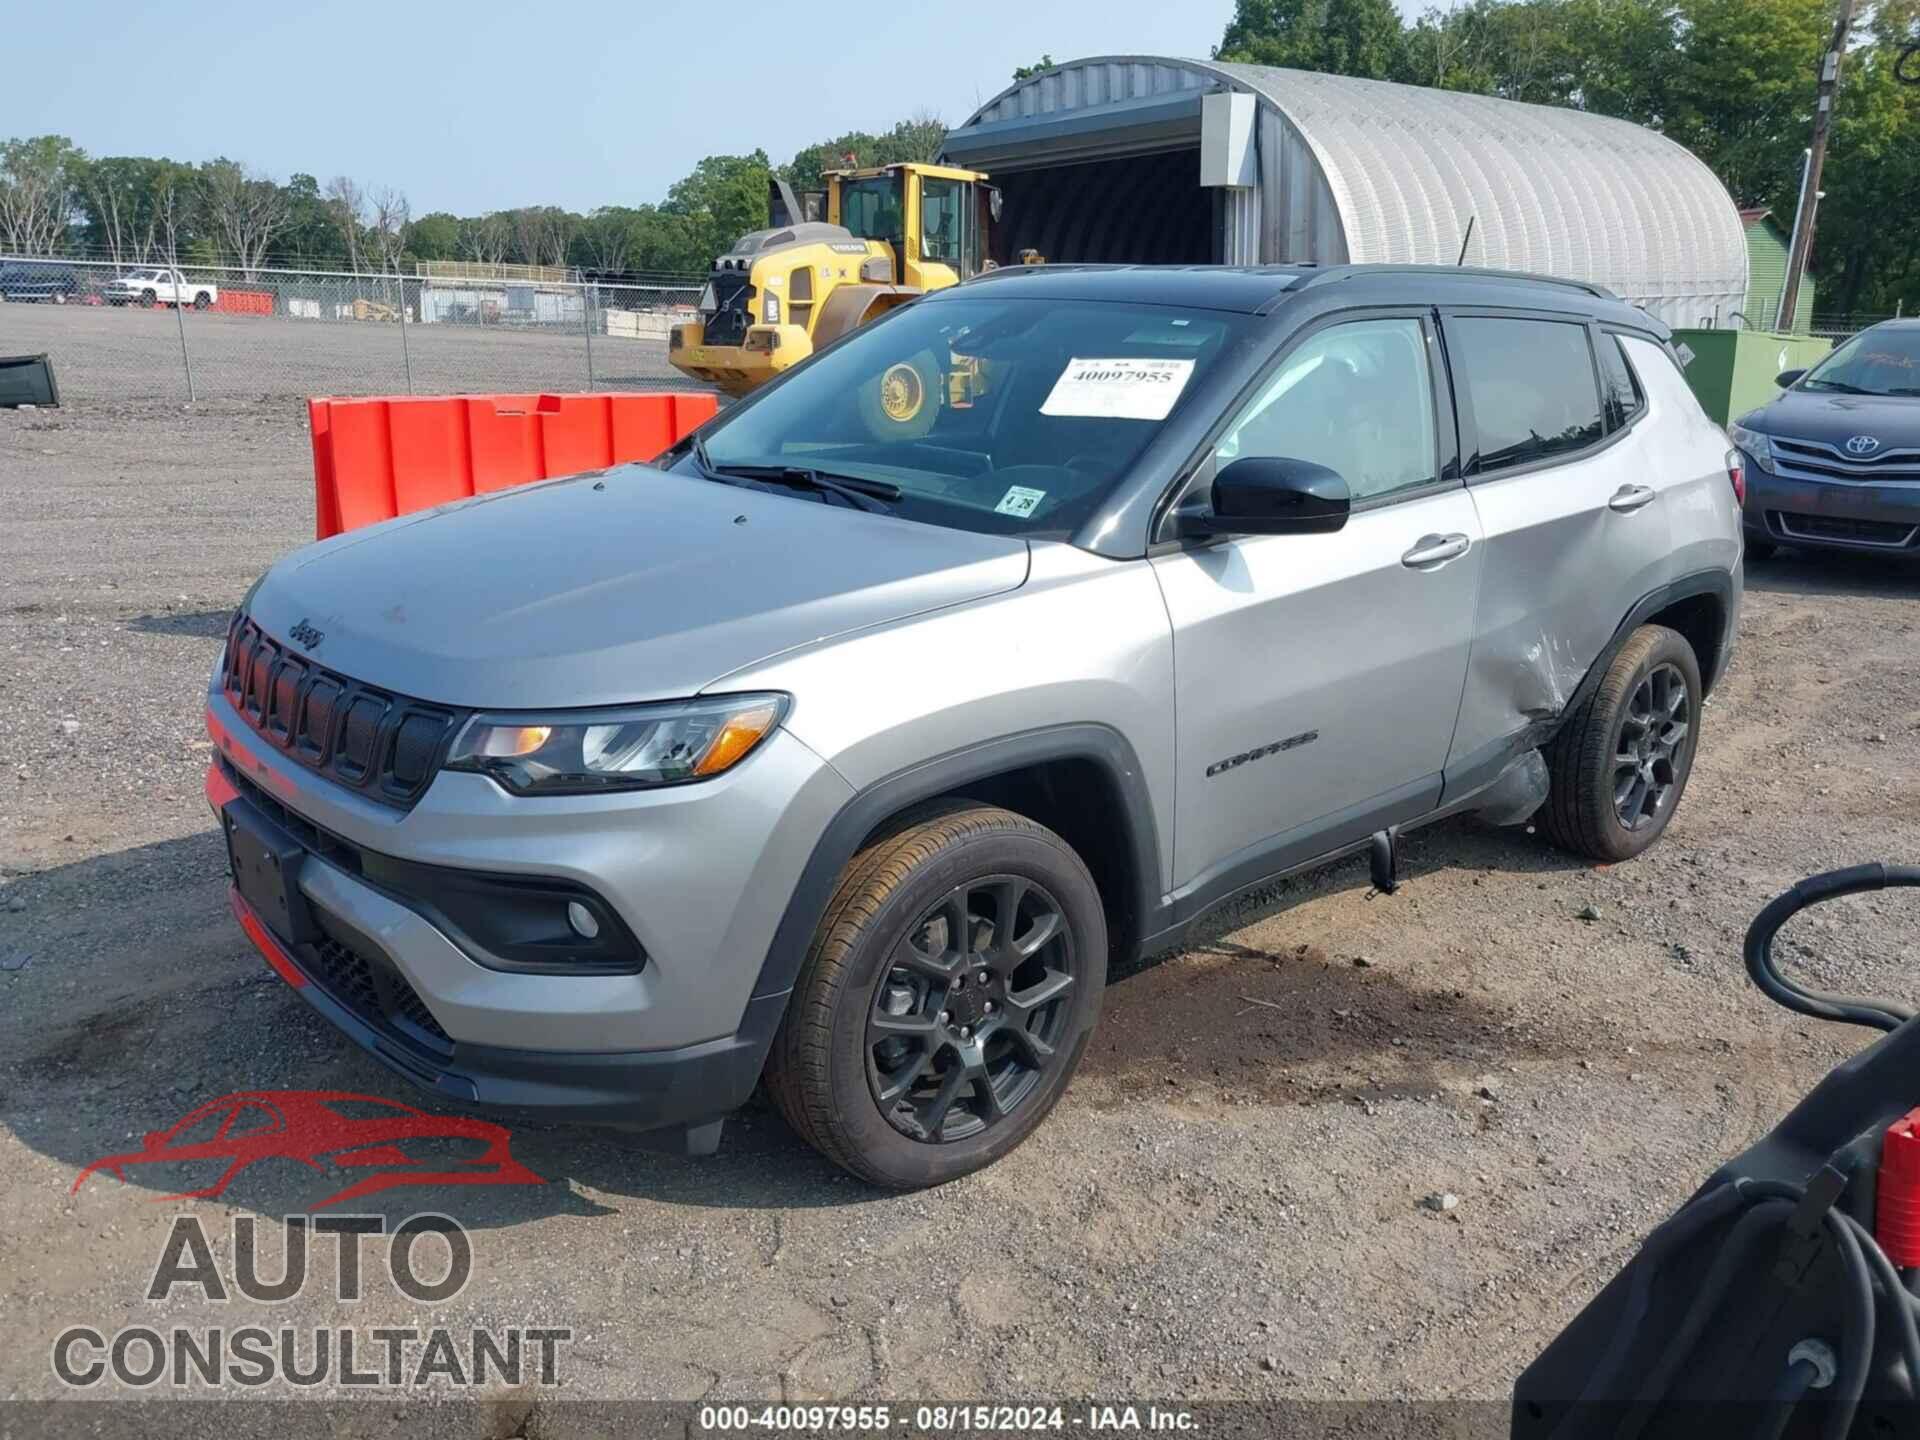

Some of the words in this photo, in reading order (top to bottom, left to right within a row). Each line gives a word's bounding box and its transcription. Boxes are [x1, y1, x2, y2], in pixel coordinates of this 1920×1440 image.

[1073, 370, 1174, 383] 40097955
[289, 617, 325, 652] Jeep
[1206, 729, 1319, 777] COMPASS
